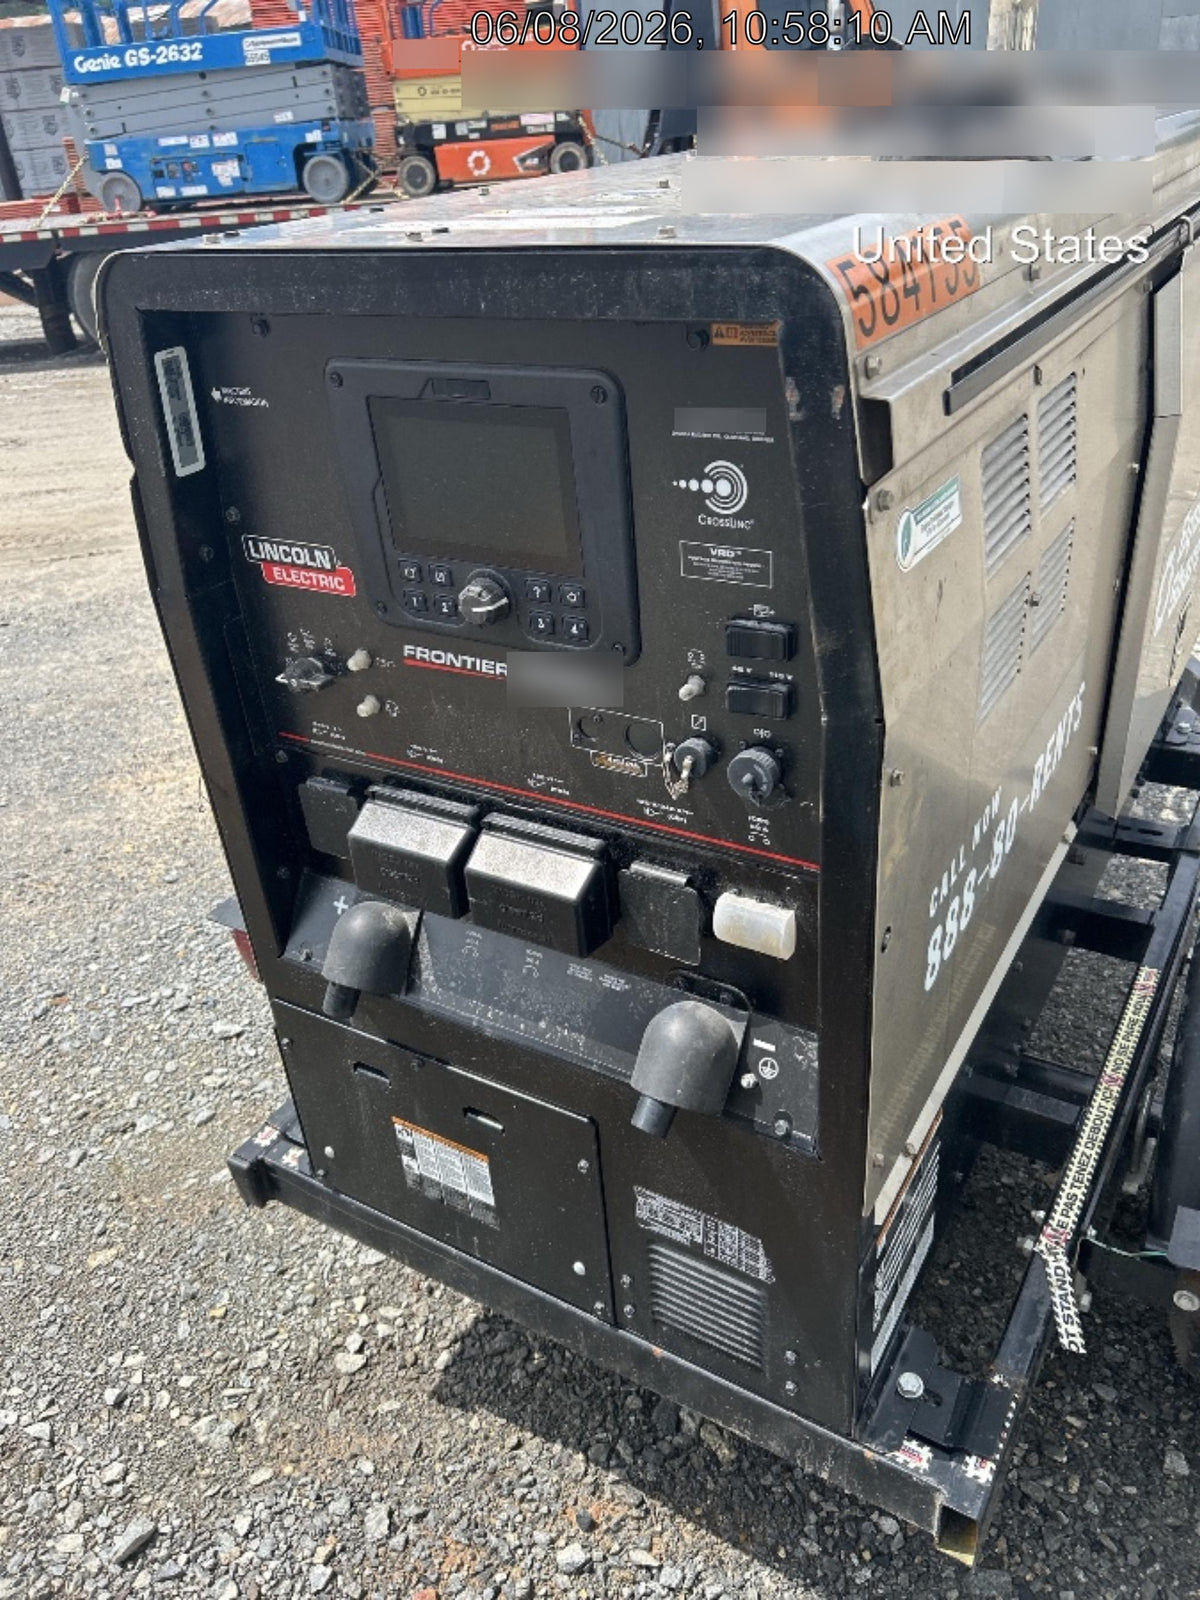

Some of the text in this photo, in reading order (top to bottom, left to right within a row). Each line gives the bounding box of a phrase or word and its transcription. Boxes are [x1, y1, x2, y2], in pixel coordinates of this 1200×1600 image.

[74, 42, 203, 74] Genie GS-2632
[247, 539, 332, 570] LINCOLN
[271, 566, 346, 591] ELECTRIC
[403, 644, 508, 677] FRONTIER
[924, 681, 1087, 992] 888-80-RENTS
[929, 784, 1003, 918] CALL NOW
[1110, 1056, 1125, 1075] NO
[1060, 1192, 1078, 1219] PAS
[1070, 1151, 1092, 1190] TENEZ
[1084, 1104, 1109, 1150] DEBOUT
[1054, 1265, 1075, 1326] STAND
